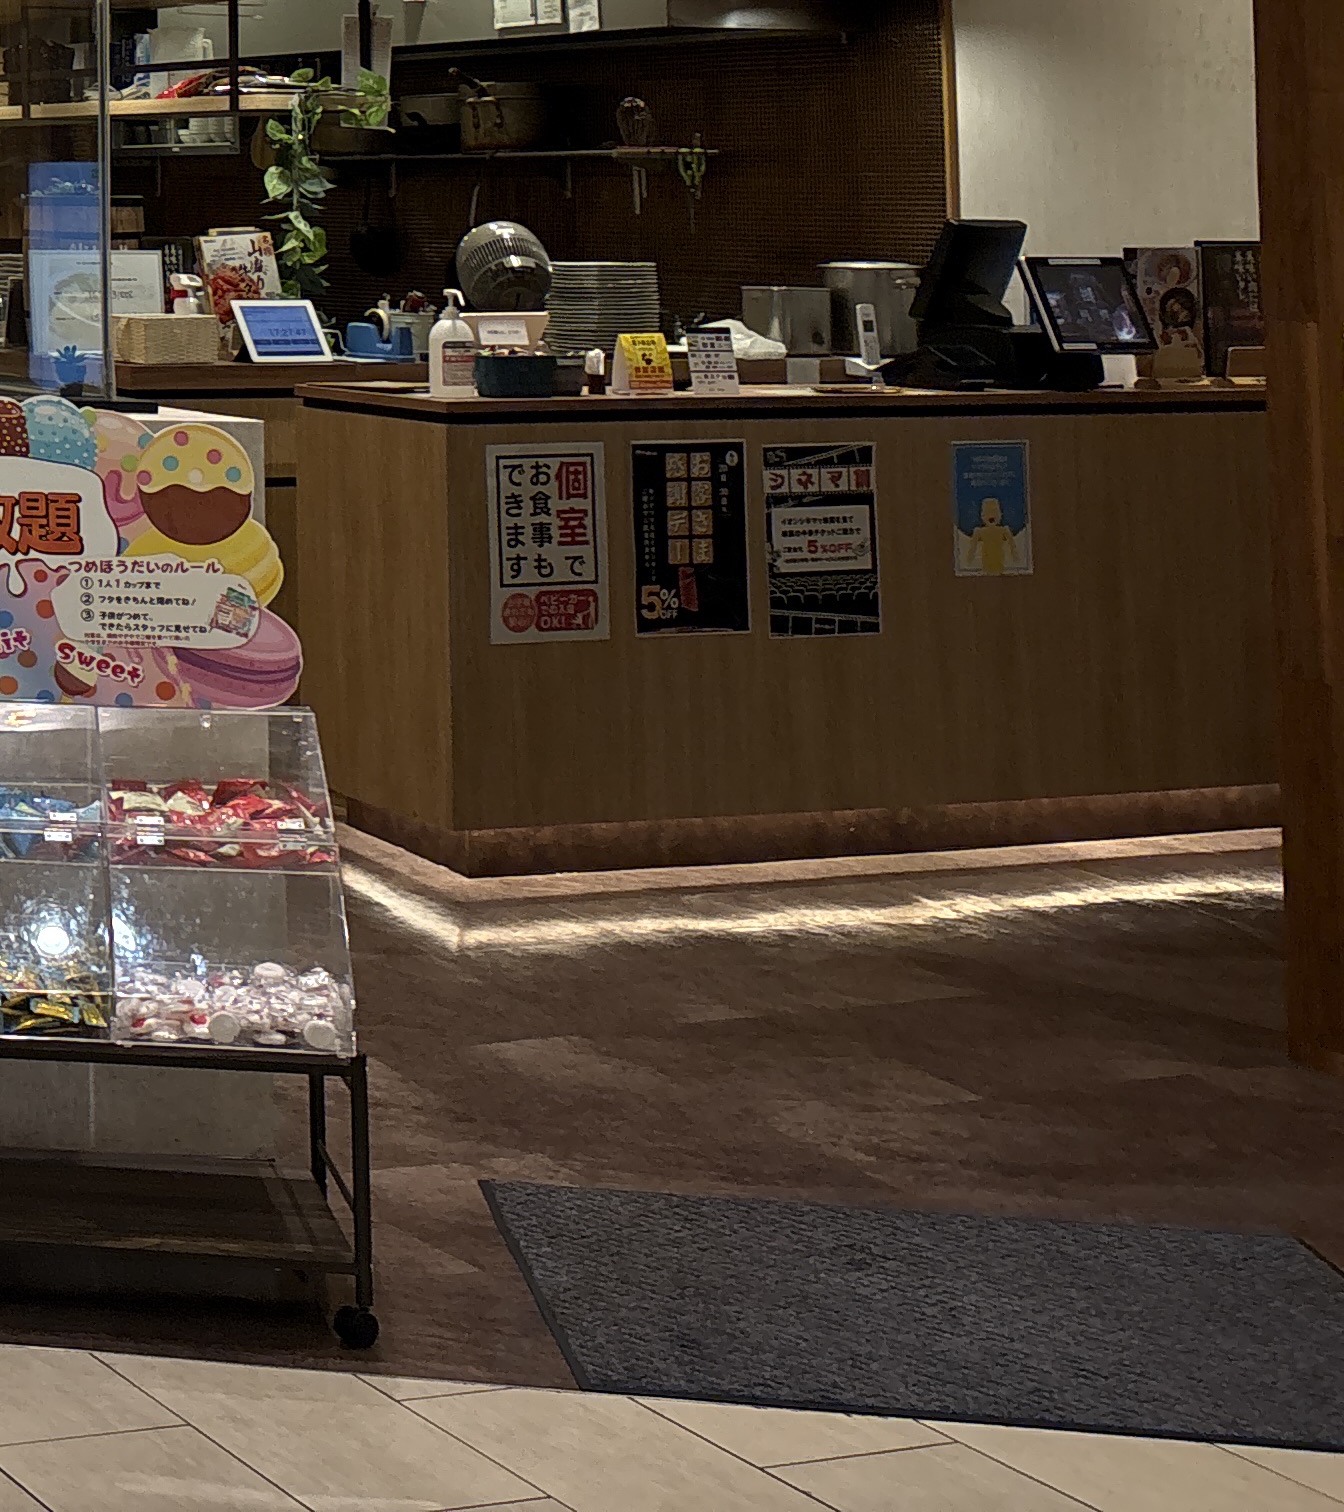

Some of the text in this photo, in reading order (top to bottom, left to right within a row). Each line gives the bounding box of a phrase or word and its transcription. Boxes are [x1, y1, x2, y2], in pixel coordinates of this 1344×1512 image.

[502, 463, 528, 580] できます
[529, 460, 555, 579] お食事も
[555, 460, 590, 577] 個室で
[56, 641, 144, 685] Sweet
